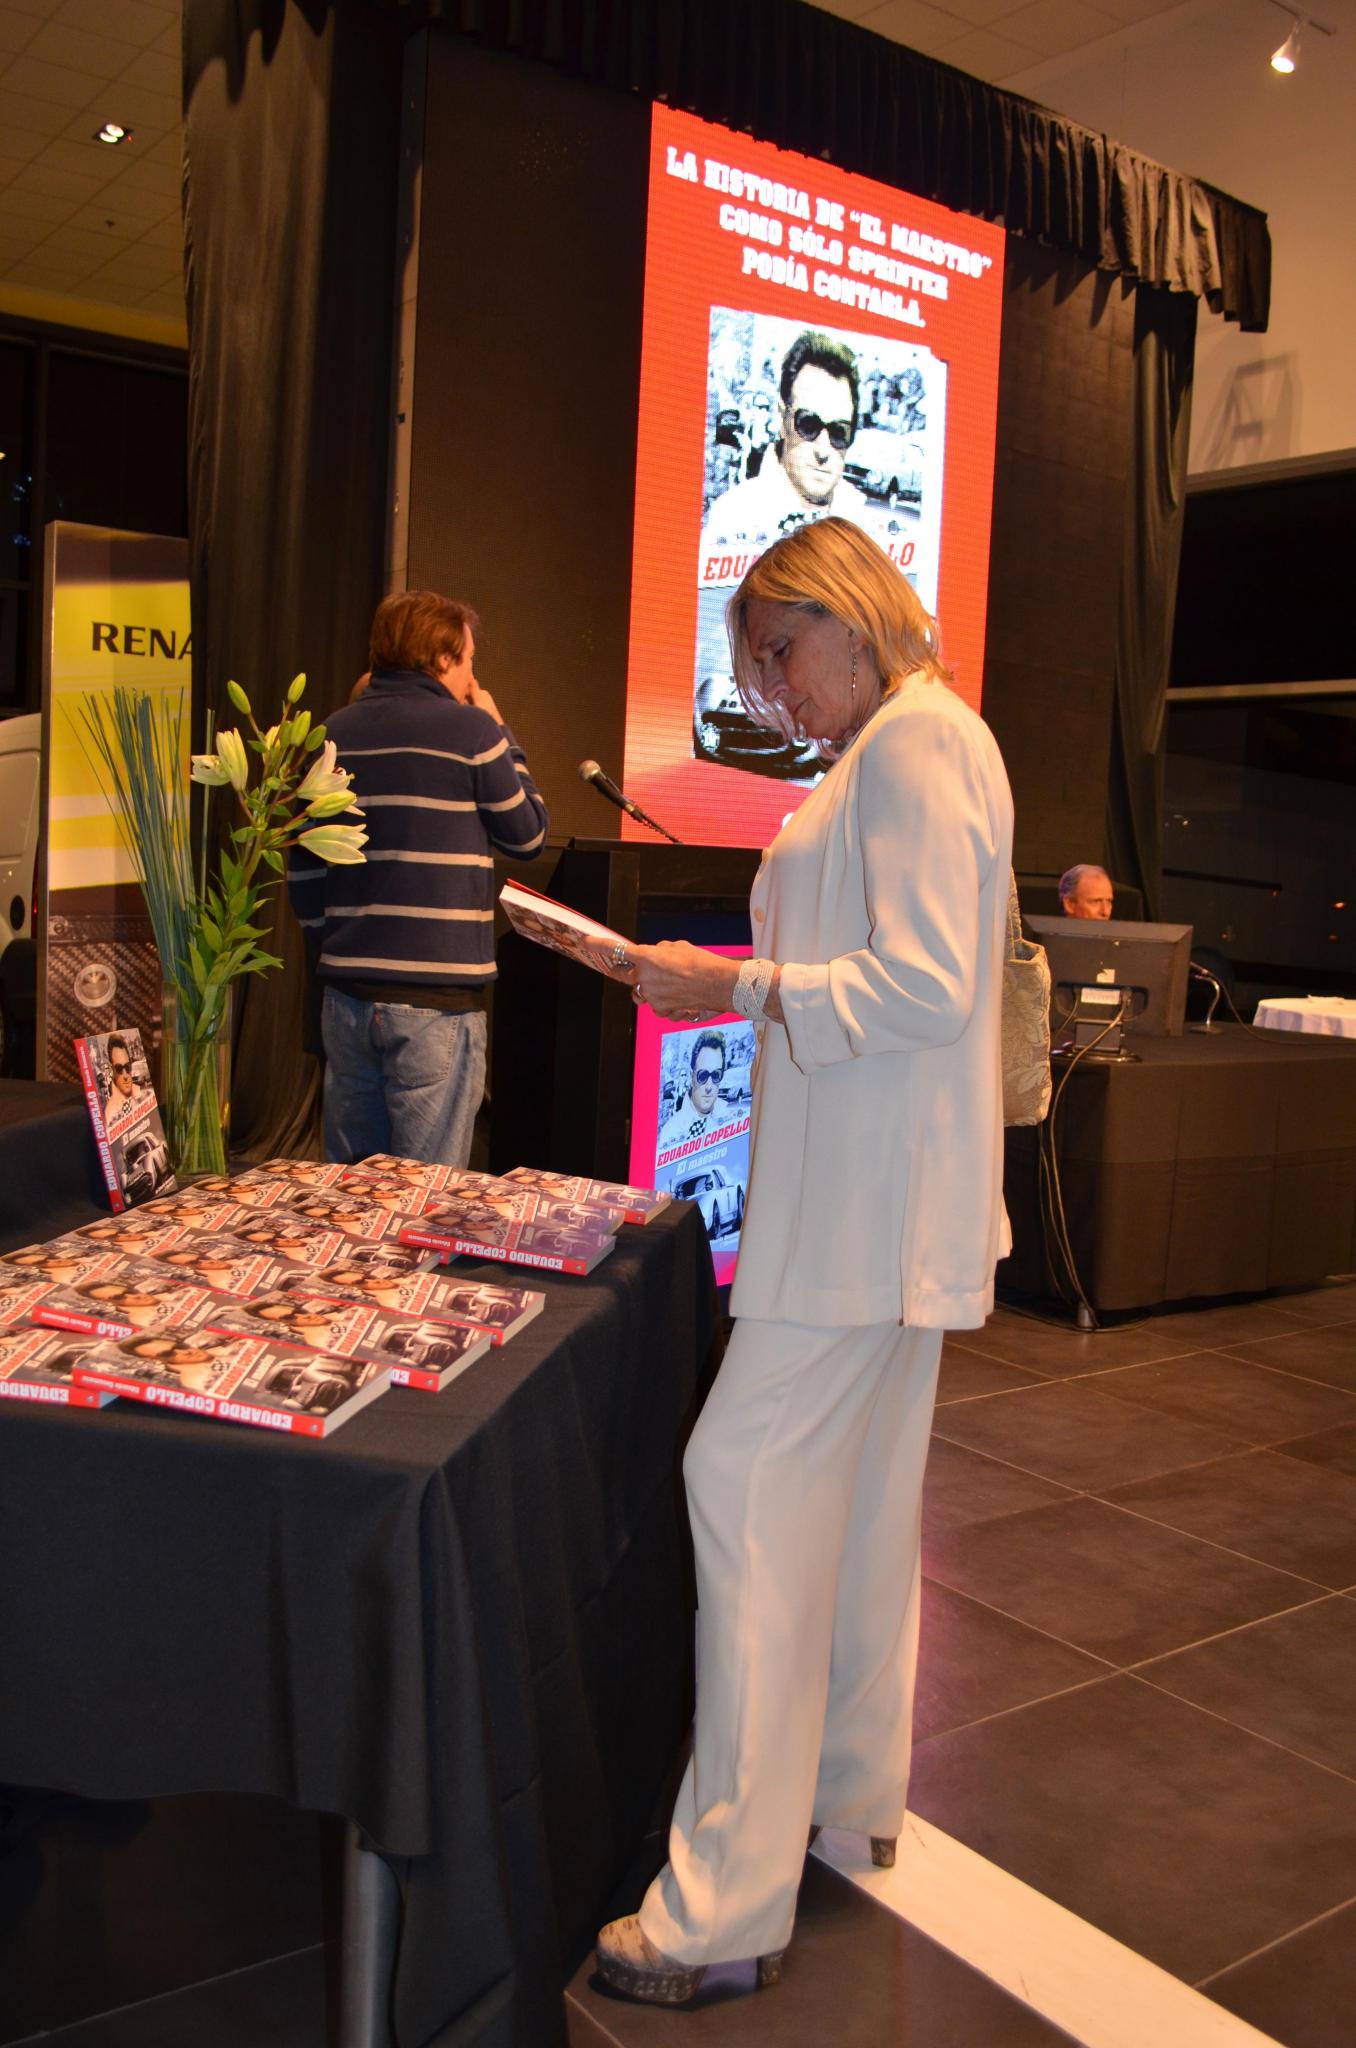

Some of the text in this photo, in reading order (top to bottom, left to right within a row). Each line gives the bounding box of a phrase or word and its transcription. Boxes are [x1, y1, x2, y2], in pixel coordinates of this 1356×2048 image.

[666, 146, 698, 183] LA
[704, 159, 810, 220] HISTORIA
[815, 197, 845, 232] DE
[720, 204, 948, 300] COMO SÓLO SPRINTER
[742, 247, 926, 328] PODÍA CONTARLA.
[87, 1090, 117, 1191] EDUARDO COPELLO
[657, 1117, 750, 1168] EDUARDO COPELLO
[676, 1147, 728, 1176] El maestro
[455, 1240, 507, 1260] COPELLO
[509, 1251, 564, 1270] EDUARDO
[0, 1380, 70, 1404] EDUARDO
[146, 1386, 216, 1413] COPELLO
[220, 1401, 294, 1429] EDUARDO
